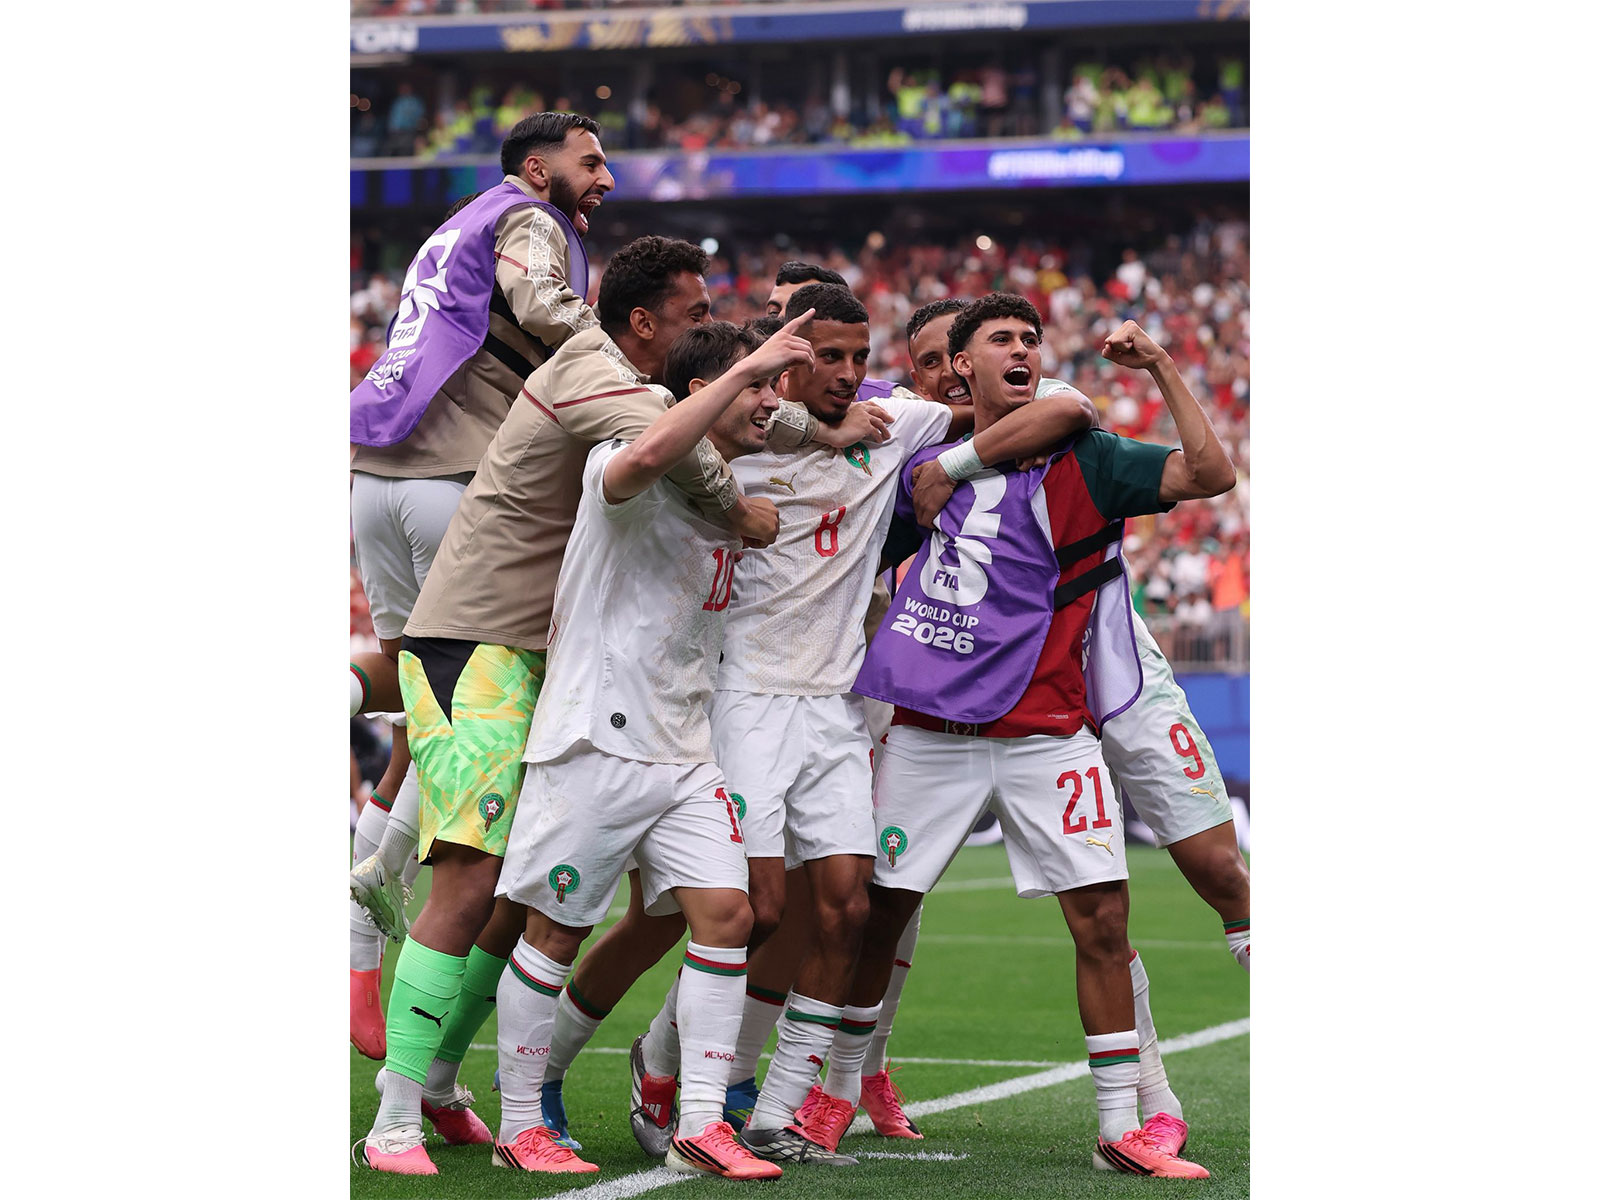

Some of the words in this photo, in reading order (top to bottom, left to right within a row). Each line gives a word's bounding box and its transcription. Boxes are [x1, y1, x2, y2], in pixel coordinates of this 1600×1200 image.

[814, 505, 847, 558] 8
[702, 547, 735, 612] 10
[890, 613, 975, 655] 2026
[904, 596, 951, 623] WORLD
[951, 612, 979, 630] CUP
[1168, 722, 1206, 780] 9
[714, 787, 744, 844] 1
[1056, 766, 1112, 835] 21
